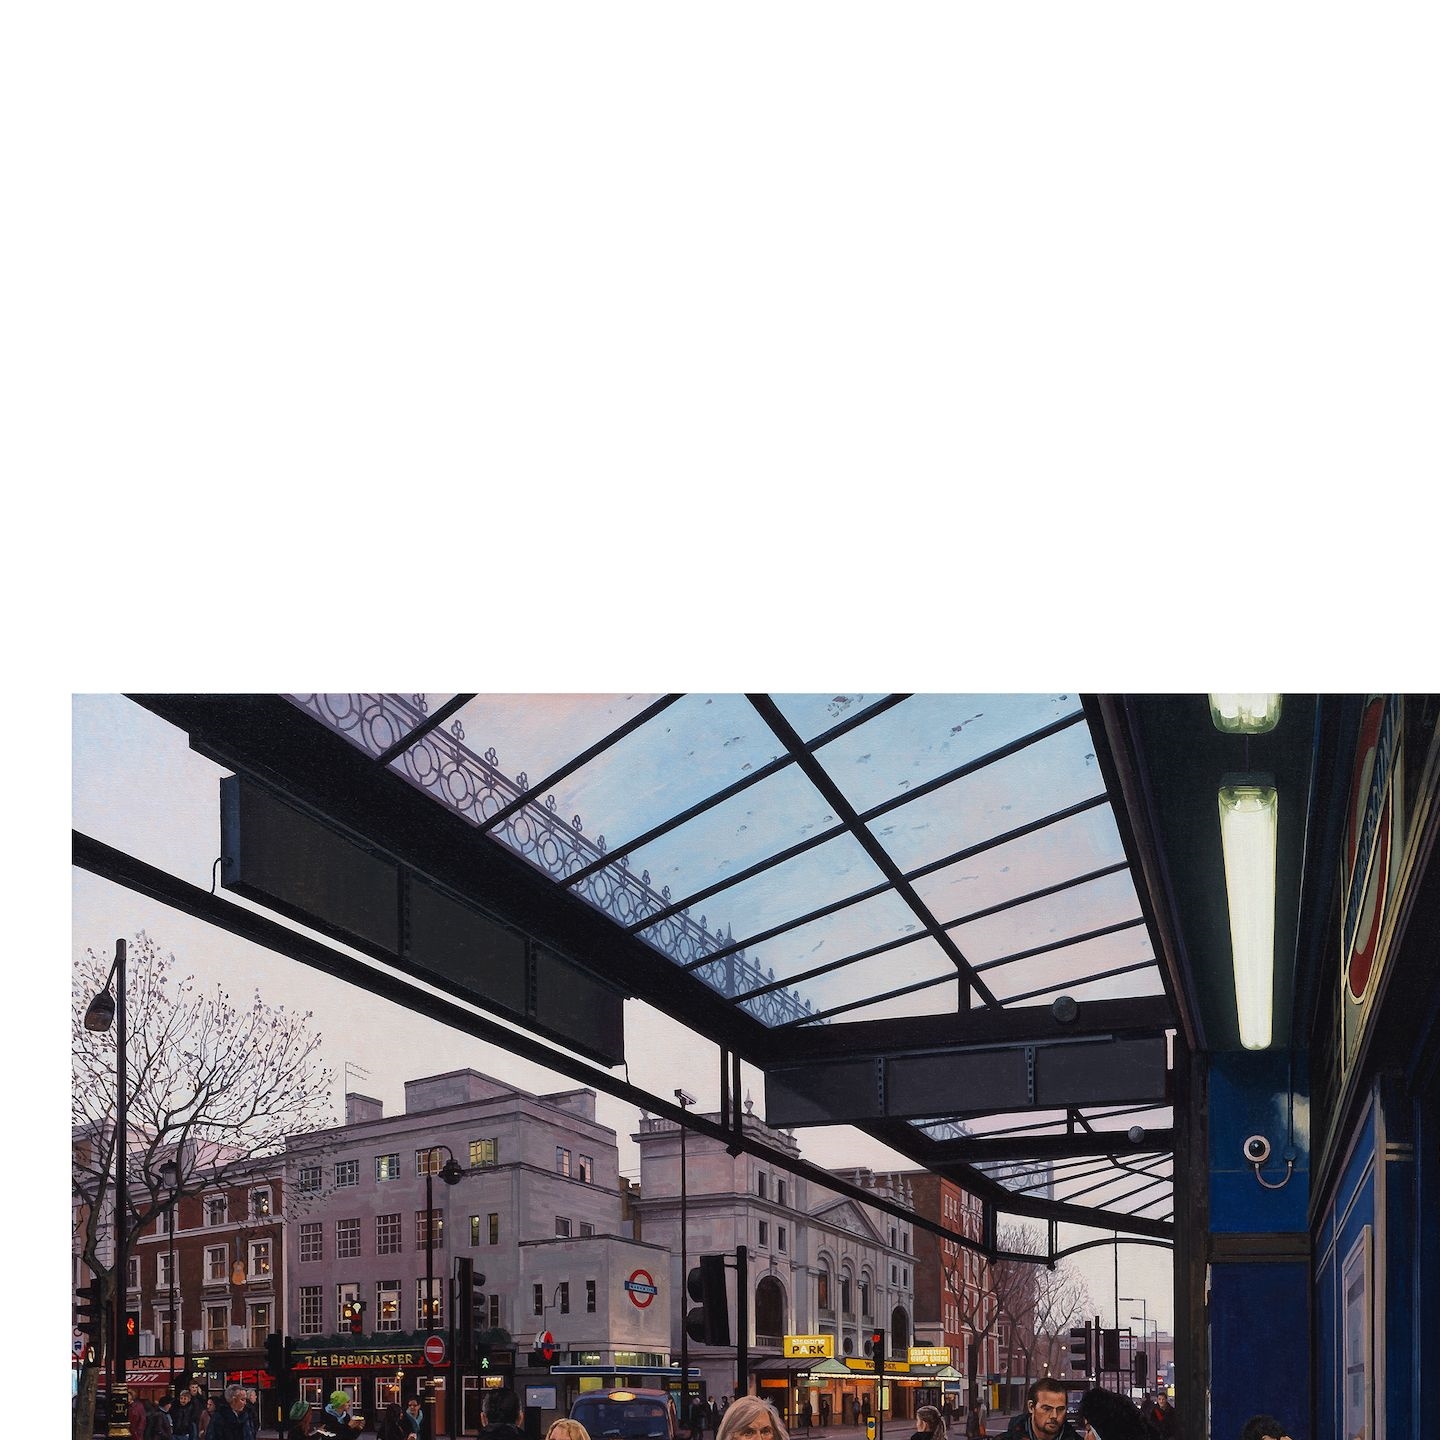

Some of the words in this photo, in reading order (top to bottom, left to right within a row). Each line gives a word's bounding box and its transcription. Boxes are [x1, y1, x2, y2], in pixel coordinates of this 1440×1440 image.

[792, 1345, 825, 1355] PARK
[132, 1359, 165, 1369] PIAZZA
[304, 1355, 328, 1367] THE
[330, 1353, 414, 1366] BREWMASTER
